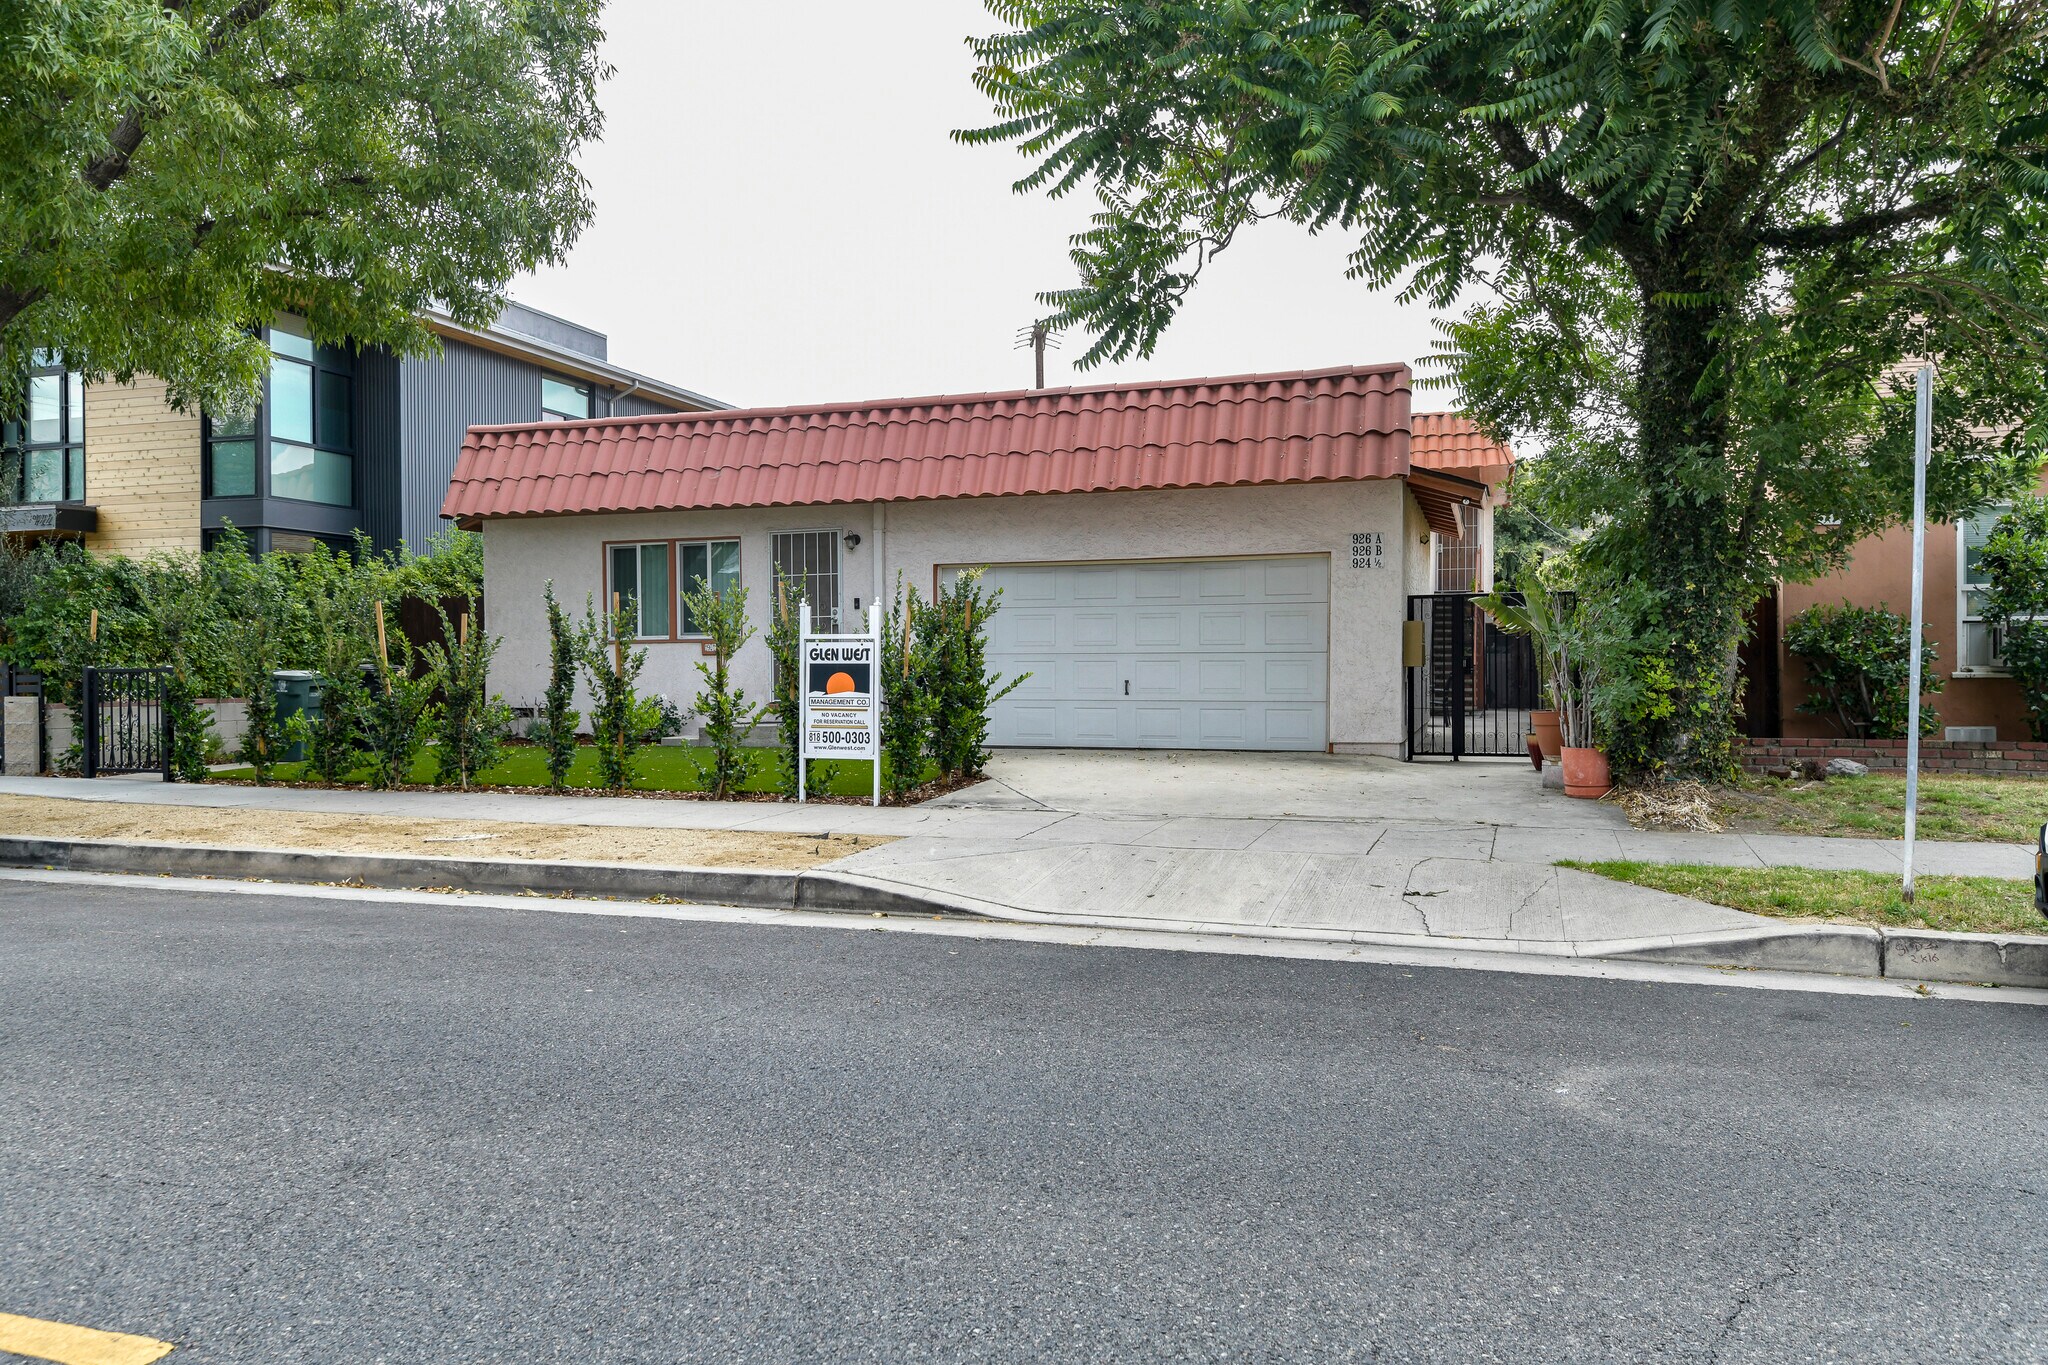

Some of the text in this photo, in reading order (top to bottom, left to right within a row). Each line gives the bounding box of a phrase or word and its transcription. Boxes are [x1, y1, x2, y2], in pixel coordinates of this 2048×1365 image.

[1352, 532, 1382, 545] 926 A
[1352, 545, 1383, 557] 926 B
[1352, 557, 1372, 569] 924
[809, 647, 871, 661] GLEN WEST
[810, 698, 869, 706] MANAGEMENT CO.
[809, 731, 871, 744] 818 500-0303
